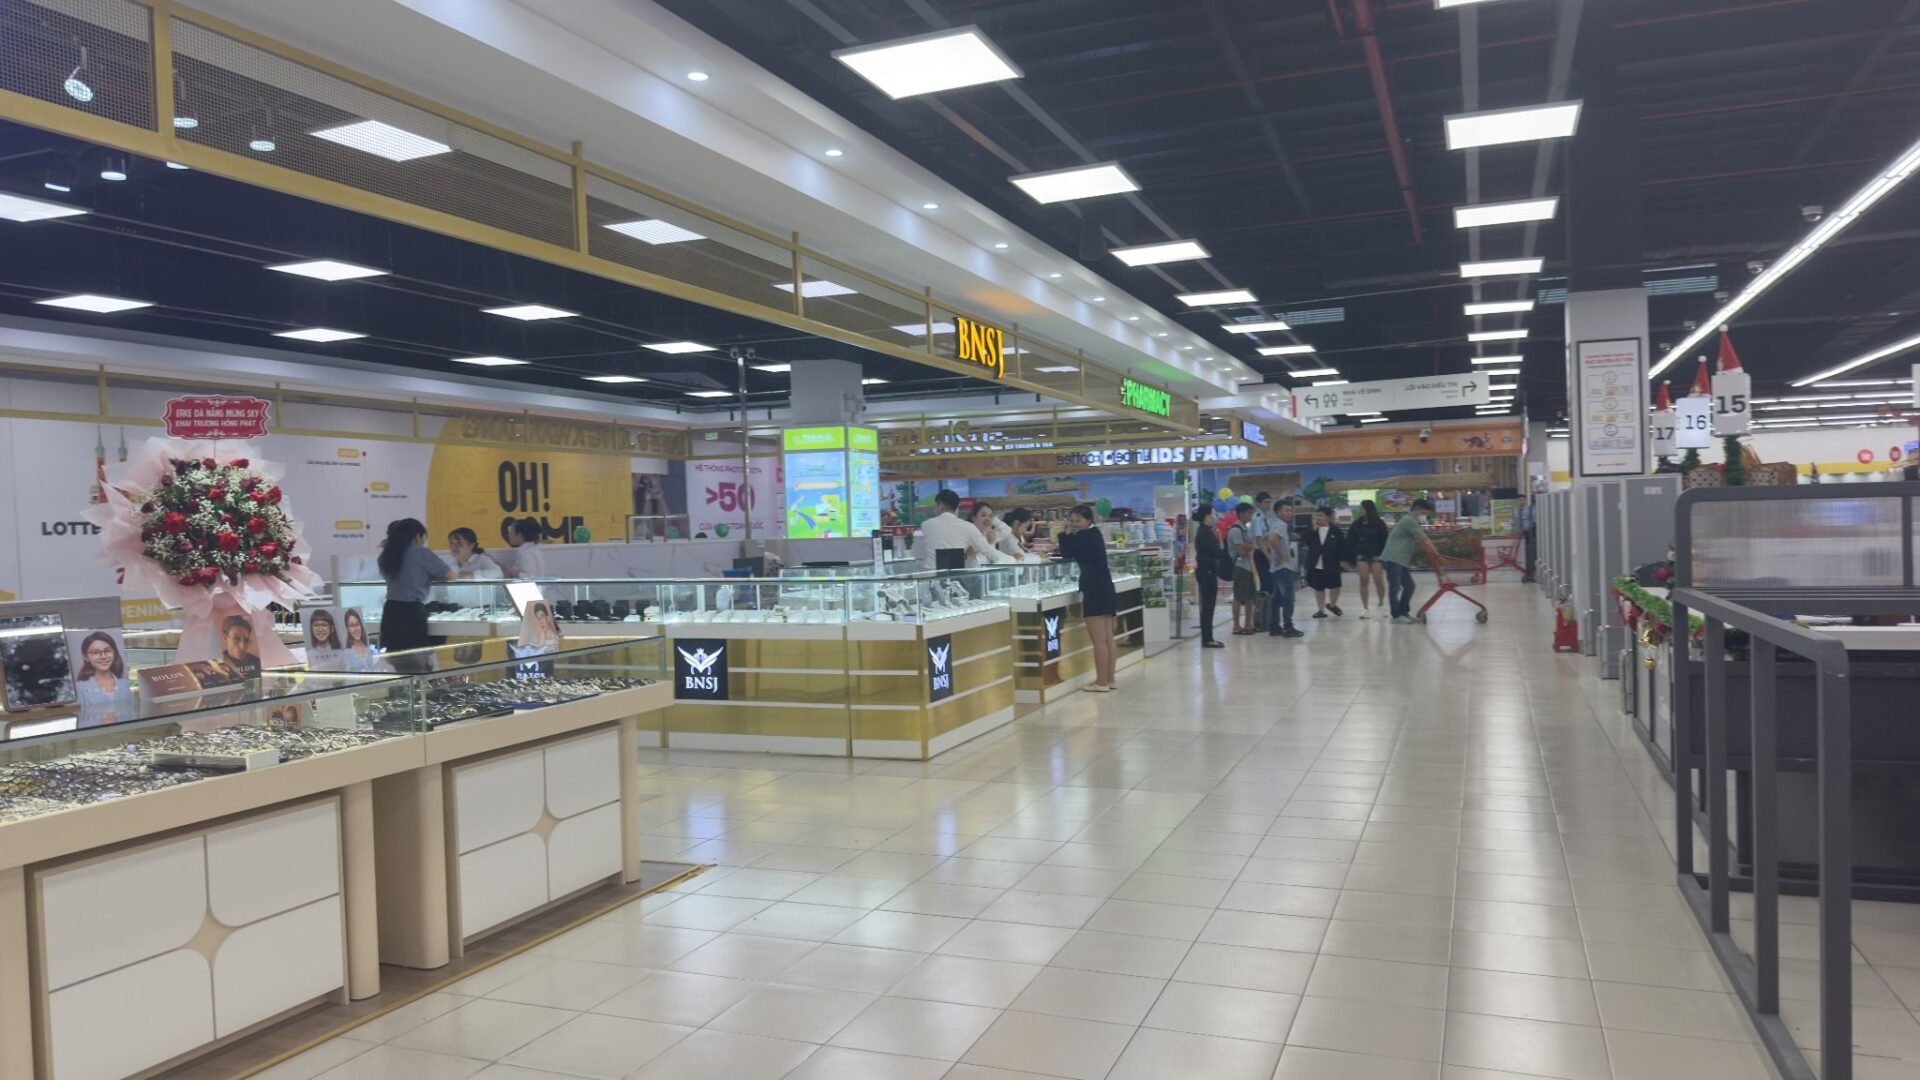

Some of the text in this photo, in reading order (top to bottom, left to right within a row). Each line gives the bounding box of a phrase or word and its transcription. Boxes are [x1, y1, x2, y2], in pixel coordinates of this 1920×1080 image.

[957, 317, 1004, 379] BNSJ
[1126, 379, 1171, 417] PHARMACY
[1717, 395, 1746, 414] 15
[175, 408, 192, 418] ERKE
[247, 408, 260, 418] SKY
[175, 419, 191, 428] KHAI
[1685, 414, 1707, 430] 16
[1656, 427, 1674, 440] 17
[1190, 444, 1248, 462] FARM
[498, 460, 550, 512] OH!
[685, 676, 718, 693] BNSJ
[933, 674, 949, 690] BNSJ
